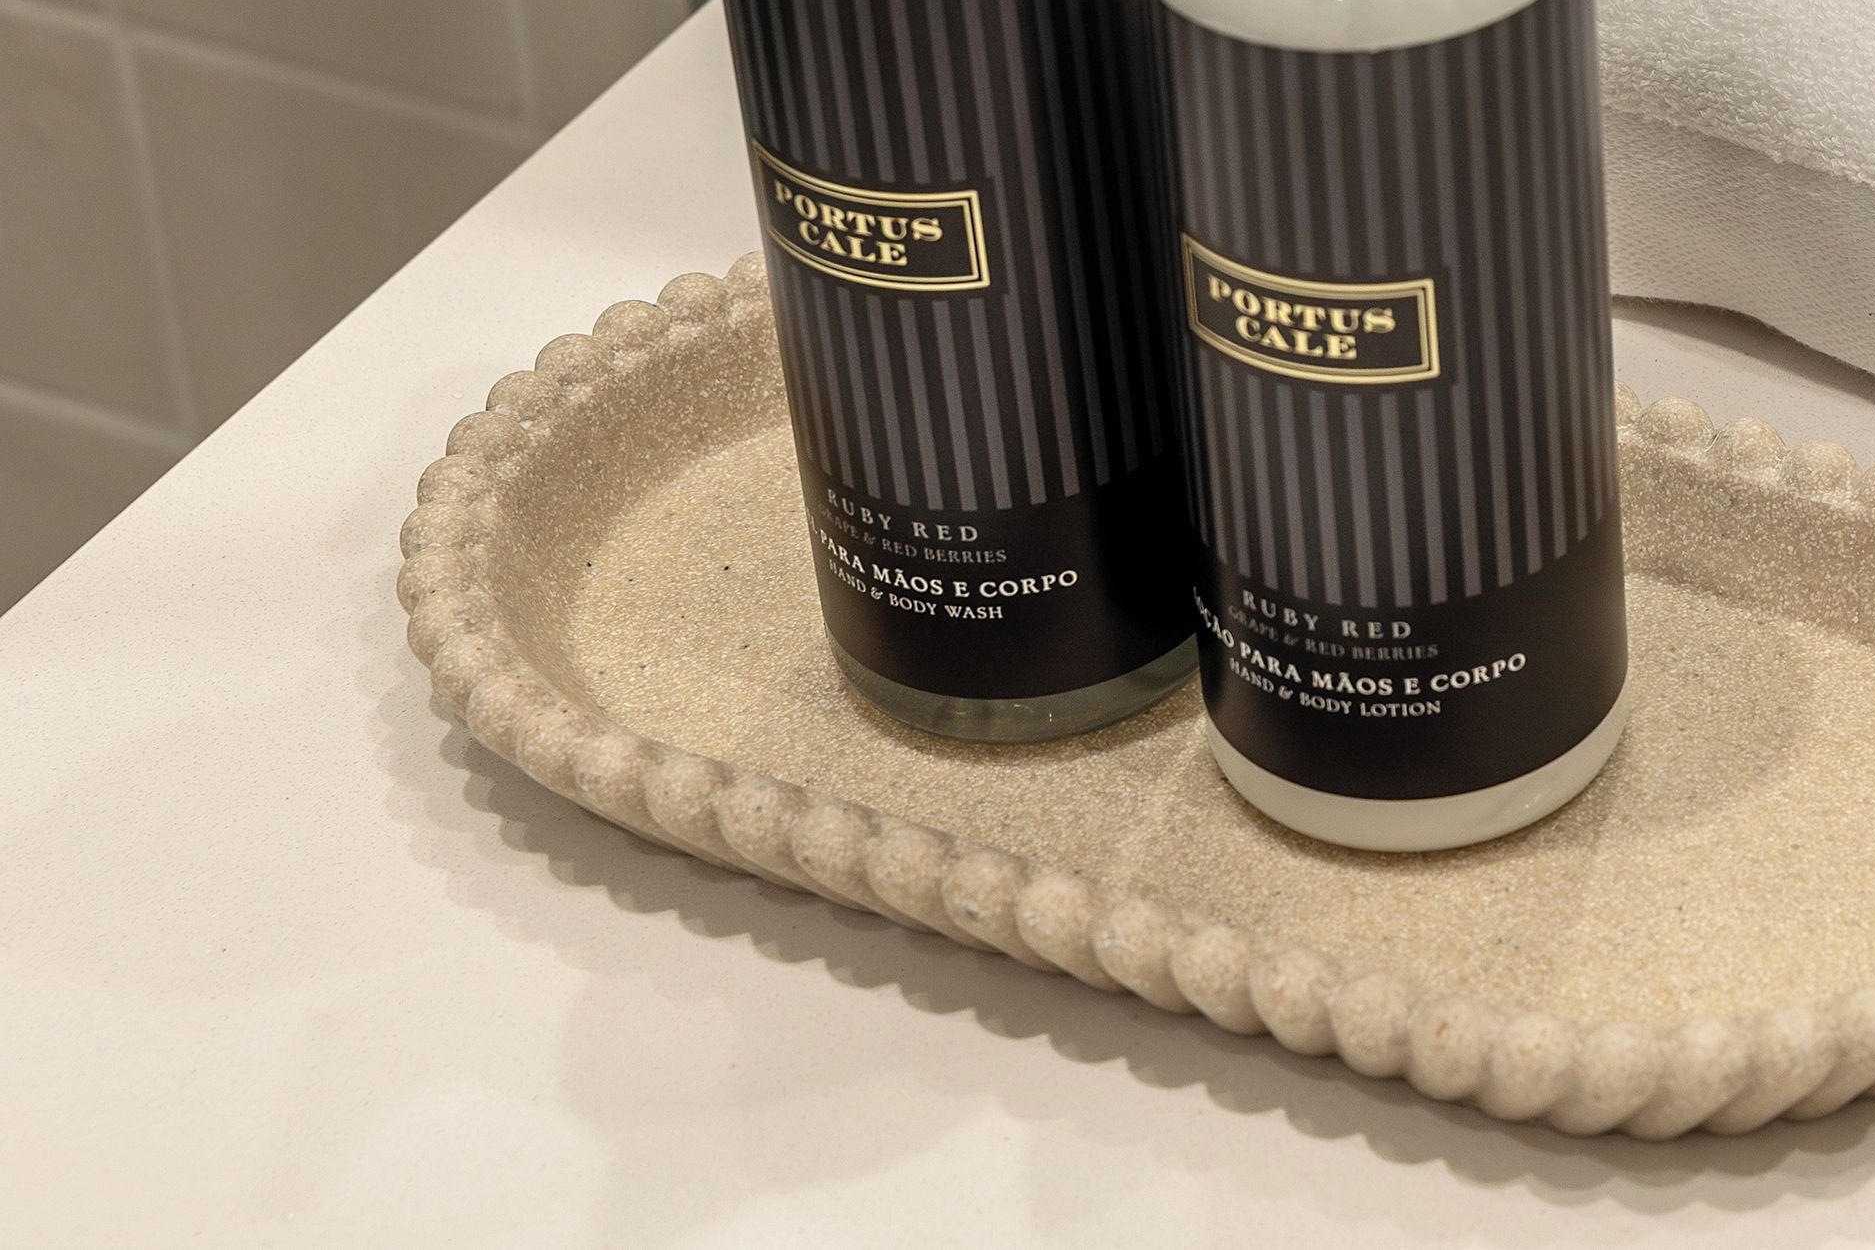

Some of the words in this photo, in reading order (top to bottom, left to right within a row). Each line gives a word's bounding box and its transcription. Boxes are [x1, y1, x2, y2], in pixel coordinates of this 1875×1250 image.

[773, 178, 944, 243] PORTUS
[798, 219, 908, 267] CALE
[1206, 271, 1397, 334] PORTUS
[1233, 313, 1358, 360] CALE
[827, 488, 892, 531] RUBY
[912, 521, 979, 543] RED
[820, 529, 866, 573] PARA
[872, 563, 944, 596] MÃOS
[953, 581, 970, 598] E
[979, 569, 1079, 599] CORPO
[882, 537, 918, 558] RED
[924, 548, 1008, 564] BERRIES
[829, 559, 867, 593] HAND
[870, 586, 884, 600] &
[889, 592, 938, 616] BODY
[944, 604, 1004, 620] WASH
[1242, 589, 1319, 632] RUBY
[1341, 620, 1412, 639] RED
[1239, 640, 1302, 684] PARA
[1310, 669, 1394, 696] MÃOS
[1403, 677, 1421, 696] E
[1430, 652, 1527, 693] CORPO
[1304, 637, 1346, 658] RED
[1351, 643, 1440, 661] BERRIES
[1228, 656, 1275, 693] HAND
[1277, 684, 1295, 701] &
[1299, 690, 1353, 715] BODY
[1360, 700, 1442, 718] LOTION
